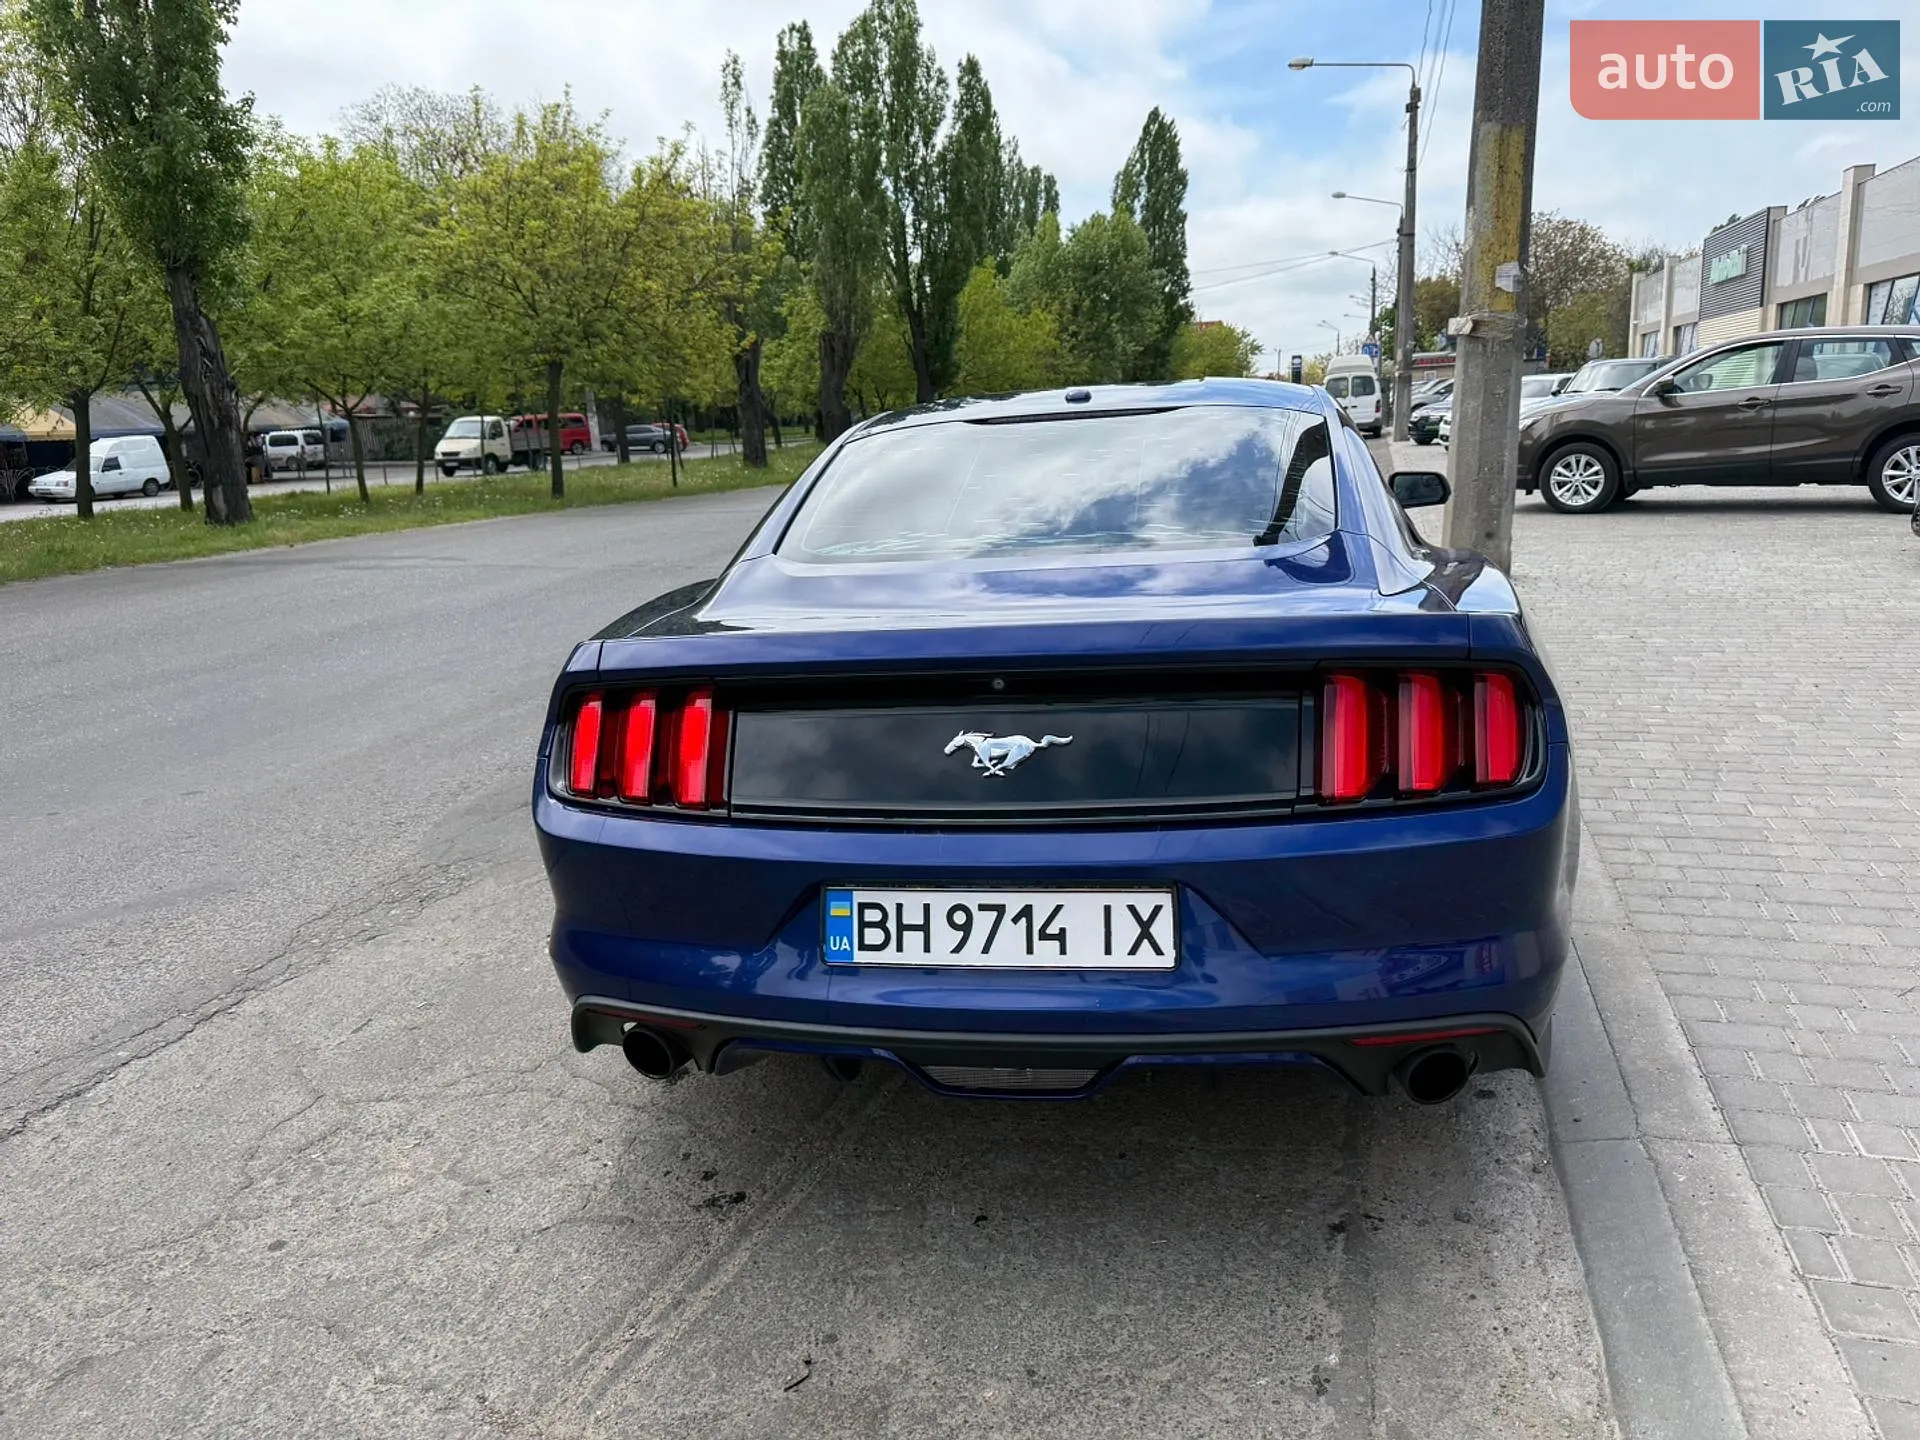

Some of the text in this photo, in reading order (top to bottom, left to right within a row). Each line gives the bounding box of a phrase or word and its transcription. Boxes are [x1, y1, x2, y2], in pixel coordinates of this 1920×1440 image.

[830, 935, 850, 951] UA
[857, 902, 1165, 956] BH 9714 IX
